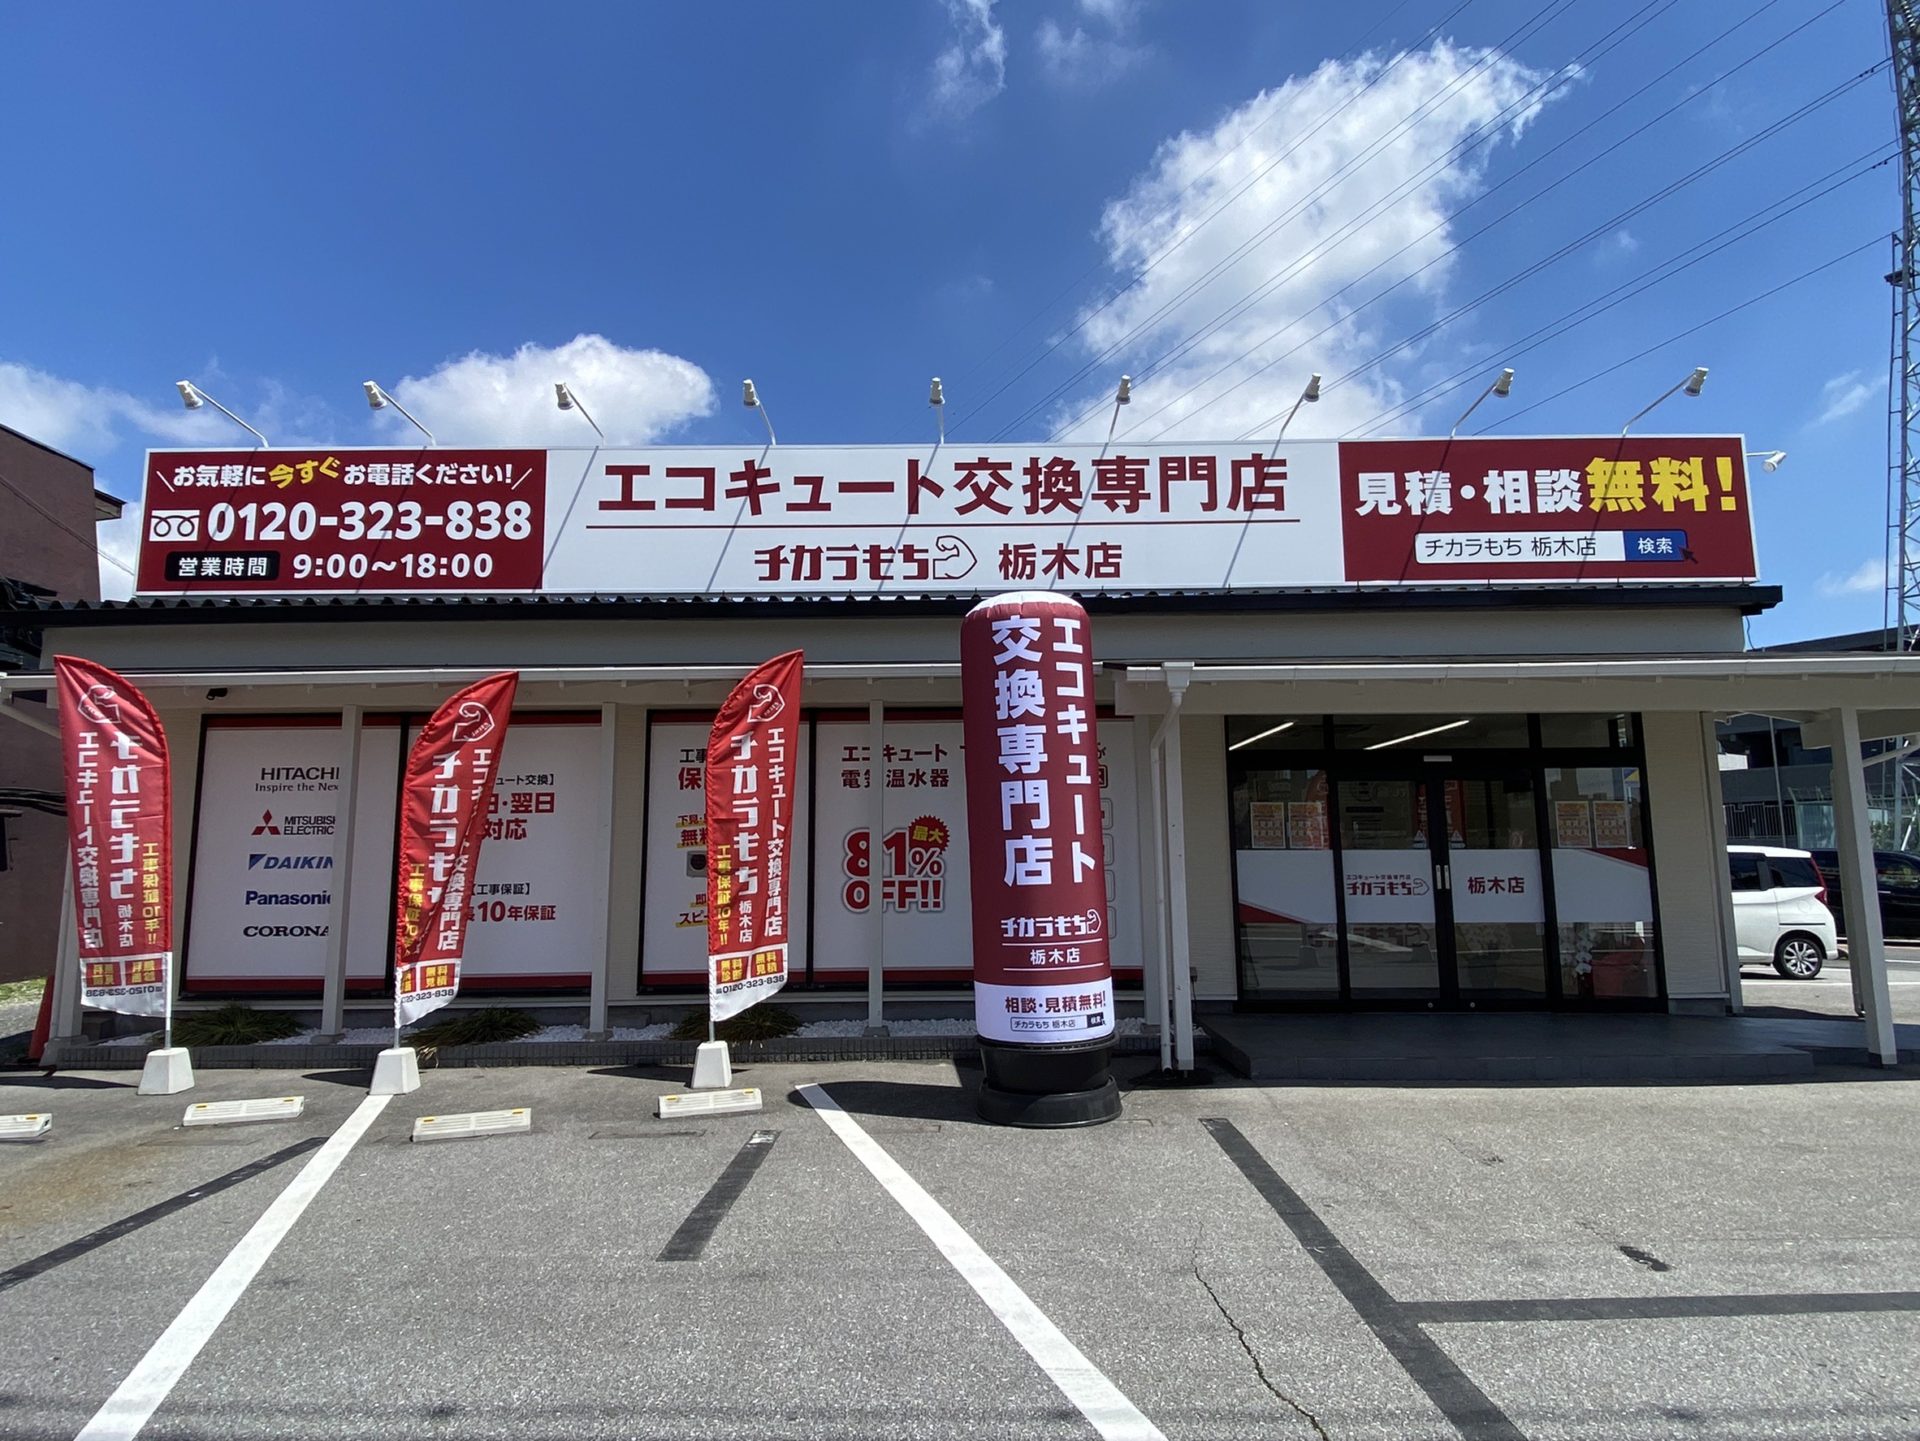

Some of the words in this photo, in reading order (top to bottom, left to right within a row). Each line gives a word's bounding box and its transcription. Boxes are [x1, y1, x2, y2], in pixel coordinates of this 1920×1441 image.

[598, 452, 1289, 516] エコキュート交換専門店
[1355, 456, 1738, 516] 見積・相談無料!
[206, 500, 532, 541] 0120-323-838
[1424, 537, 1522, 557] チカラもち
[1531, 536, 1597, 557] 栃木店
[1637, 536, 1673, 554] 検索
[178, 556, 268, 577] 営業時間
[753, 542, 931, 581] チカラもち
[998, 541, 1123, 580] 栃木店
[991, 614, 1054, 887] 交換専門店
[1052, 617, 1096, 884] エコキュート
[261, 767, 340, 780] HITACHI
[496, 774, 554, 785] ュート交換】
[678, 767, 706, 790] 保
[255, 783, 294, 793] Inspire
[297, 783, 315, 792] the
[318, 782, 339, 792] Nex
[731, 731, 760, 896] チカラもち
[284, 826, 334, 835] ELECTRIC
[764, 728, 786, 937] エコキュート交換専門店
[912, 825, 944, 843] 最大
[1346, 882, 1412, 896] チカラもち
[1467, 877, 1525, 894] 栃木店
[738, 900, 753, 943] 栃木店
[1000, 914, 1087, 937] チカラもち
[1029, 947, 1081, 965] 栃木店
